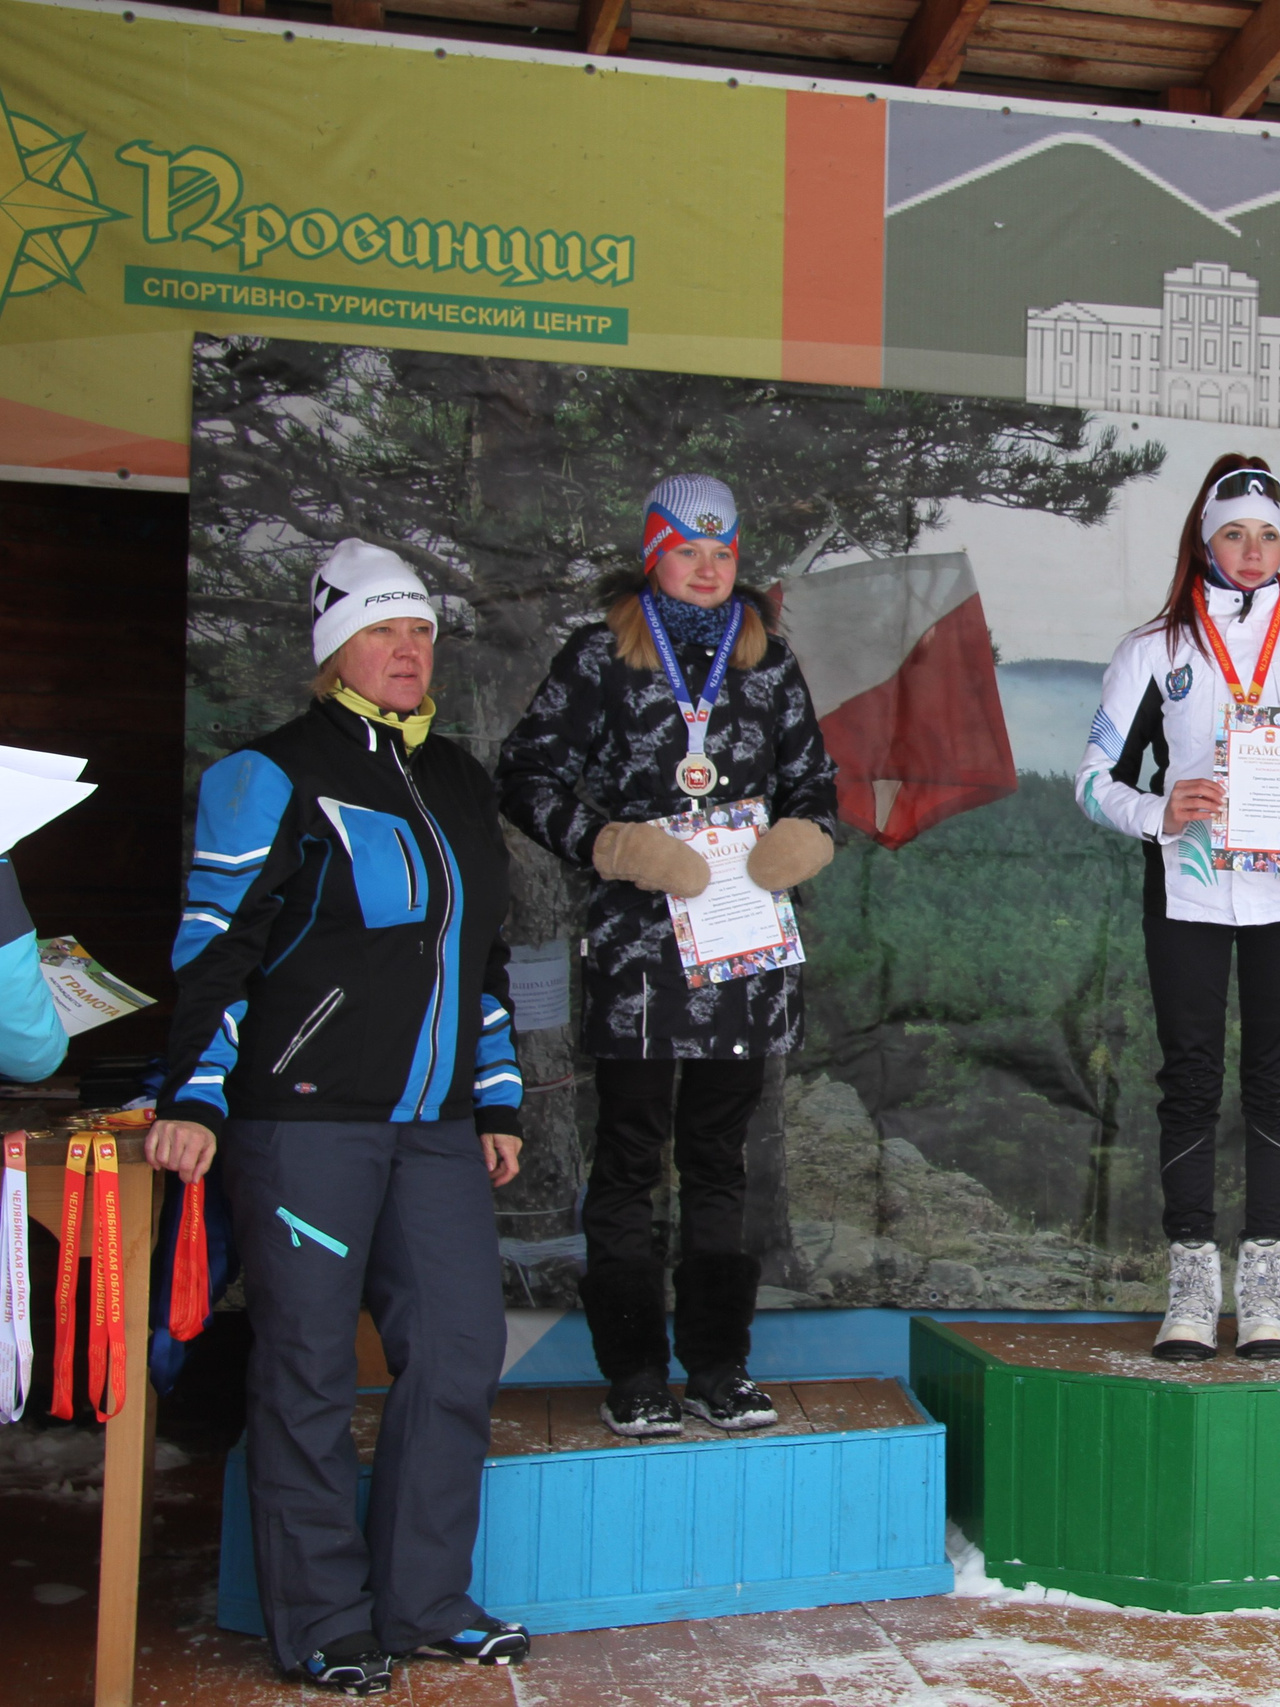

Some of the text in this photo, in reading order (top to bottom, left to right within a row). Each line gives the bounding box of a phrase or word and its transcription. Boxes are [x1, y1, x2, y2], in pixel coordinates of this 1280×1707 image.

[116, 139, 635, 287] Провинция
[142, 275, 612, 336] СПОРТИВНО-ТУРИСТИЧЕСКИЙ ЦЕНТР
[643, 525, 673, 558] RUSSIA
[364, 591, 426, 607] FISCHER
[709, 651, 728, 688] ОБЛАСТЬ
[701, 842, 750, 860] АМОТА
[60, 974, 121, 1017] ГРАМОТА
[13, 1190, 26, 1321] ЧЕЛЯБИНСКАЯ ОБЛАСТЬ
[59, 1192, 79, 1325] ЧЕЛЯБИНСКАЯ ОБЛАСТЬ
[105, 1191, 120, 1323] ЧЕЛЯБИНСКАЯ ОБЛАСТЬ
